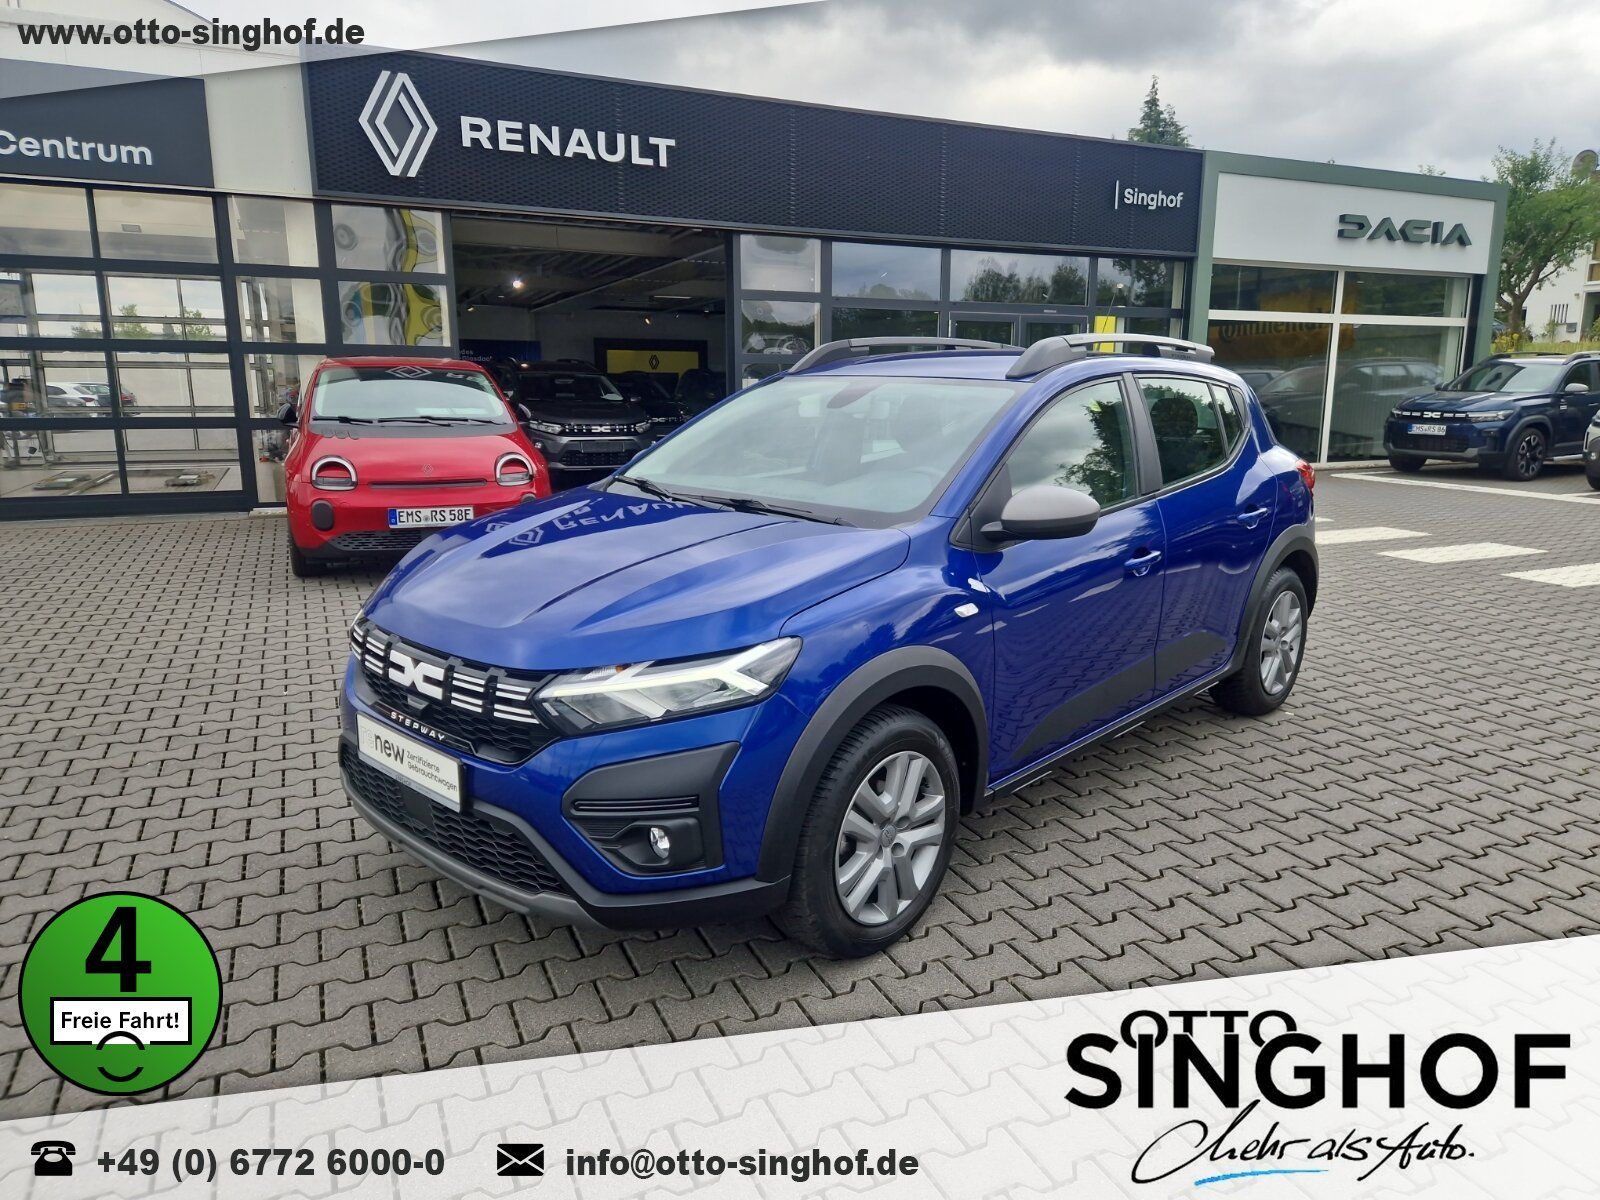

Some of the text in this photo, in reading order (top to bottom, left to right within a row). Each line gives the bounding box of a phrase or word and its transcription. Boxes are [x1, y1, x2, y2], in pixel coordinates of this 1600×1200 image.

[0, 129, 153, 166] Centrum
[460, 114, 676, 168] RENAULT
[1123, 187, 1184, 211] Singhof
[1337, 213, 1472, 247] DACIA
[398, 508, 471, 524] EMS RS 58E
[390, 711, 446, 741] STEPWAY
